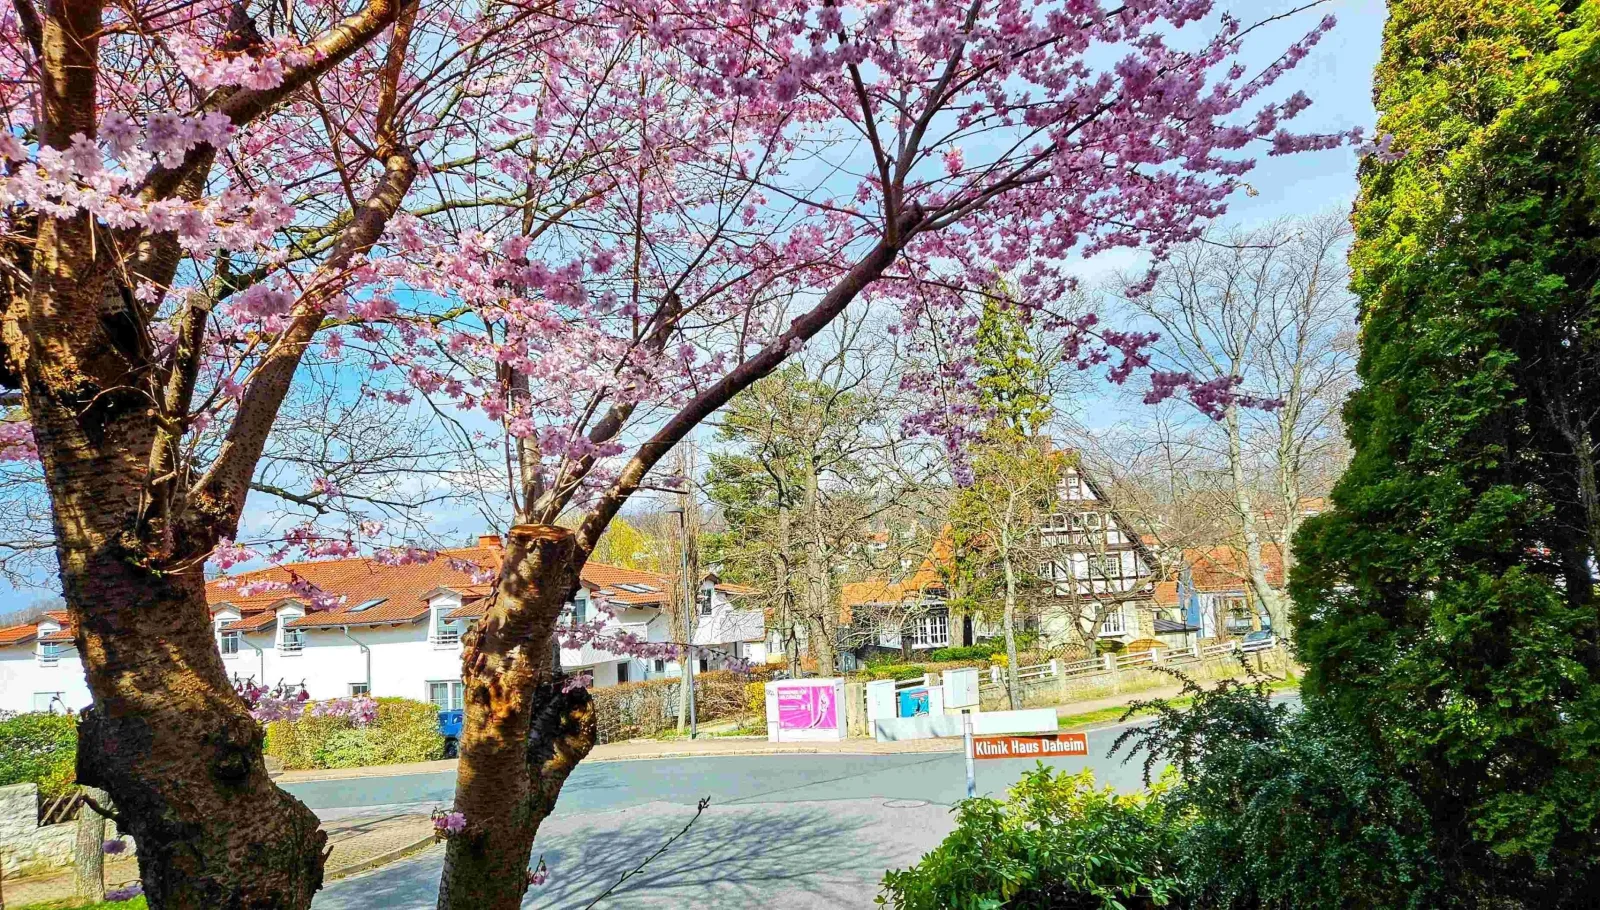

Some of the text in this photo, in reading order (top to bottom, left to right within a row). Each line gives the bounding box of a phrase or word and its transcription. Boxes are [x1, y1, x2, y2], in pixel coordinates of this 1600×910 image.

[975, 738, 1085, 755] Klinik Haus Daheim
